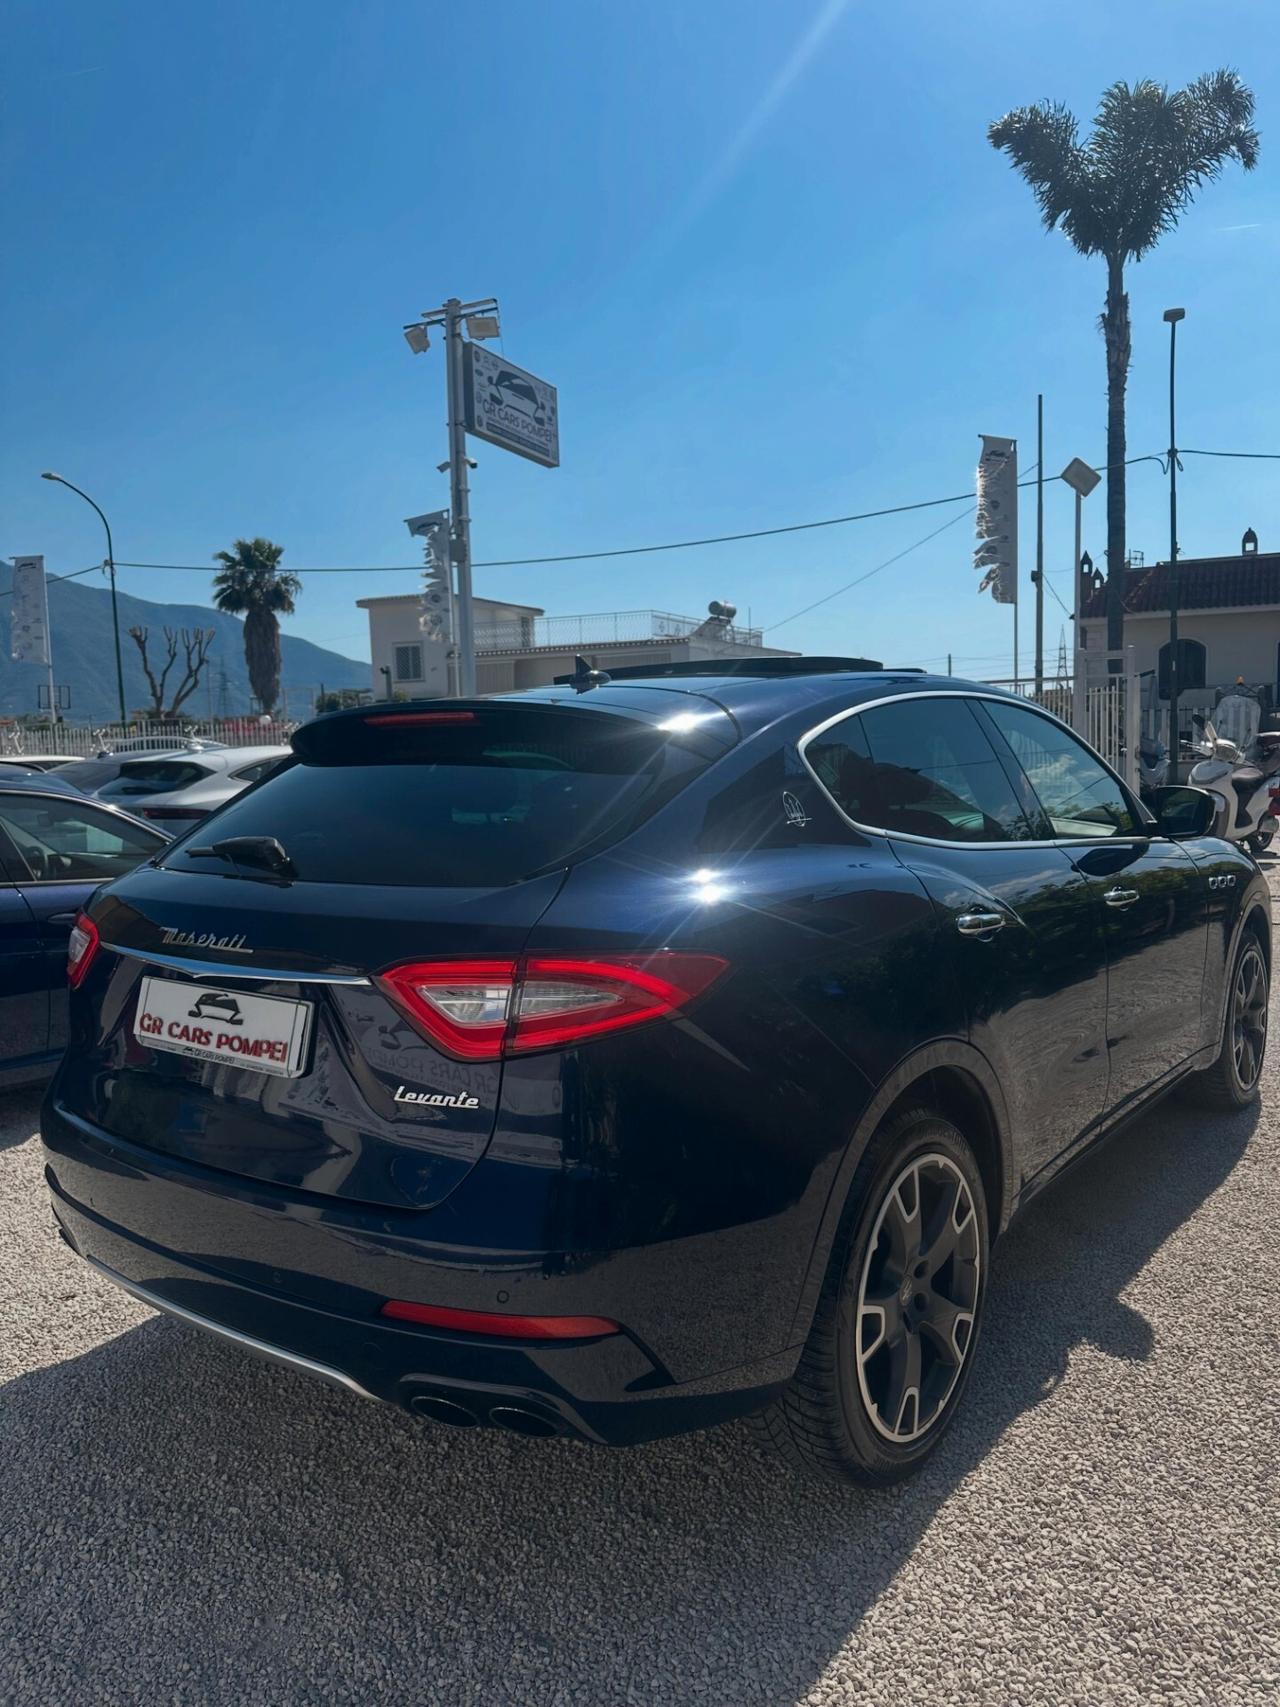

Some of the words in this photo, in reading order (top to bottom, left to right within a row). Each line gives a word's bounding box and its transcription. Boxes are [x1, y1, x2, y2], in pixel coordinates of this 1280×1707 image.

[483, 399, 496, 417] GR
[498, 408, 520, 428] CARS
[160, 926, 253, 954] Maserati
[139, 1013, 163, 1035] GR
[168, 1021, 213, 1046] CARS
[215, 1034, 288, 1063] POMPEI
[394, 1086, 479, 1109] Levante
